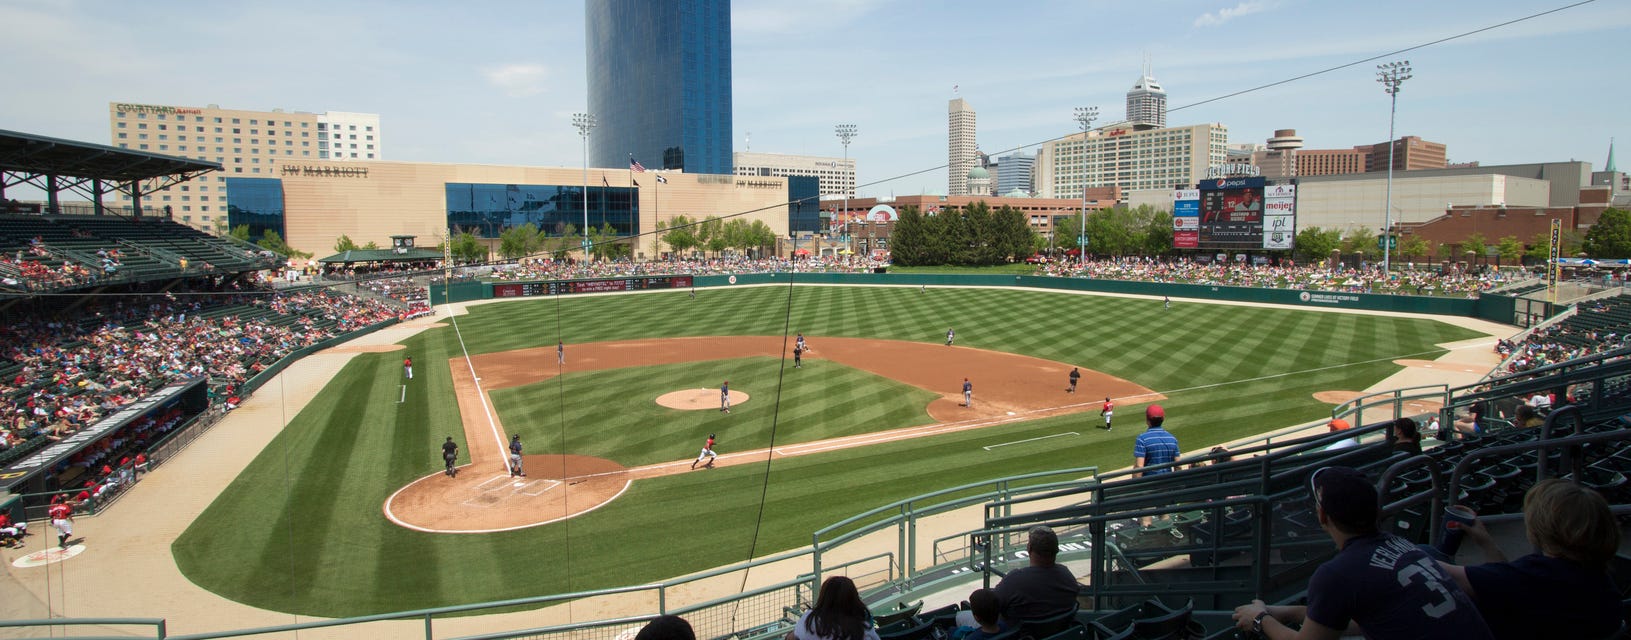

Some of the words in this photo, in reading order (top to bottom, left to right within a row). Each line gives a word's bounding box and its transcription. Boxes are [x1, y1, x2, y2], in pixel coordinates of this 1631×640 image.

[117, 103, 176, 114] COURTYARD
[281, 164, 301, 176] JW
[303, 165, 369, 178] MARRIOTT
[1237, 163, 1260, 176] FIELD
[747, 180, 783, 190] MARRIOTT
[1265, 202, 1293, 211] meijer
[1272, 216, 1286, 231] ipl
